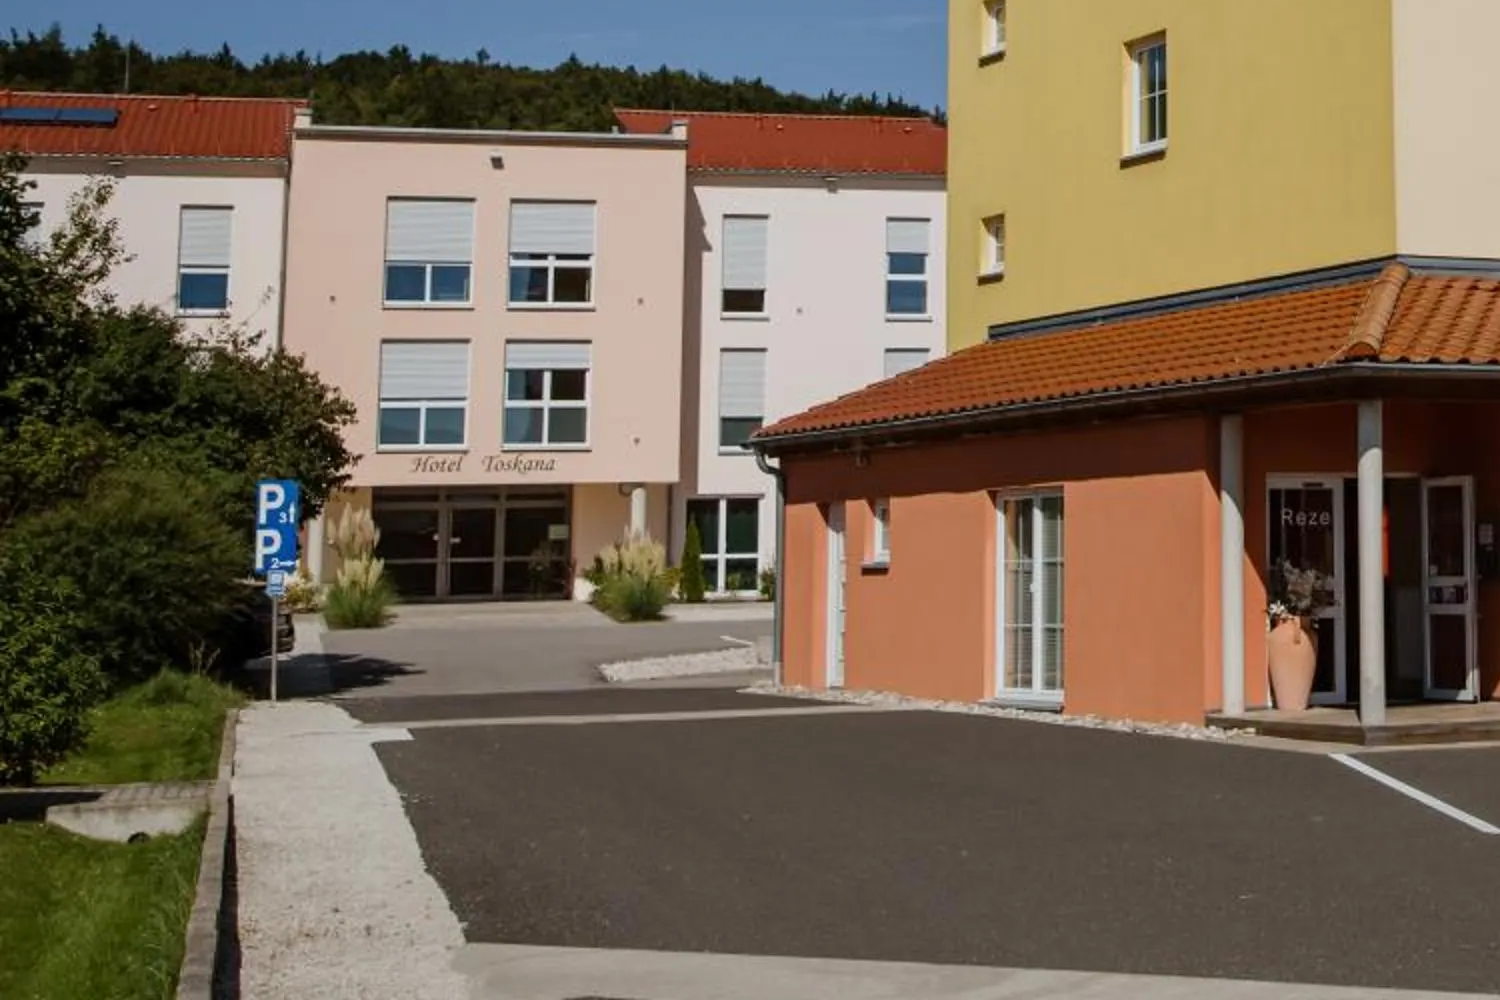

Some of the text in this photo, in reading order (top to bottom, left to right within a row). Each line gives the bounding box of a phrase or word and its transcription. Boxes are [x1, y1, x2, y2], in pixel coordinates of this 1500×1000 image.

[410, 454, 556, 475] Hotel Toskana
[258, 483, 287, 525] P 3
[1281, 508, 1331, 527] Reze
[255, 528, 281, 569] P 2
